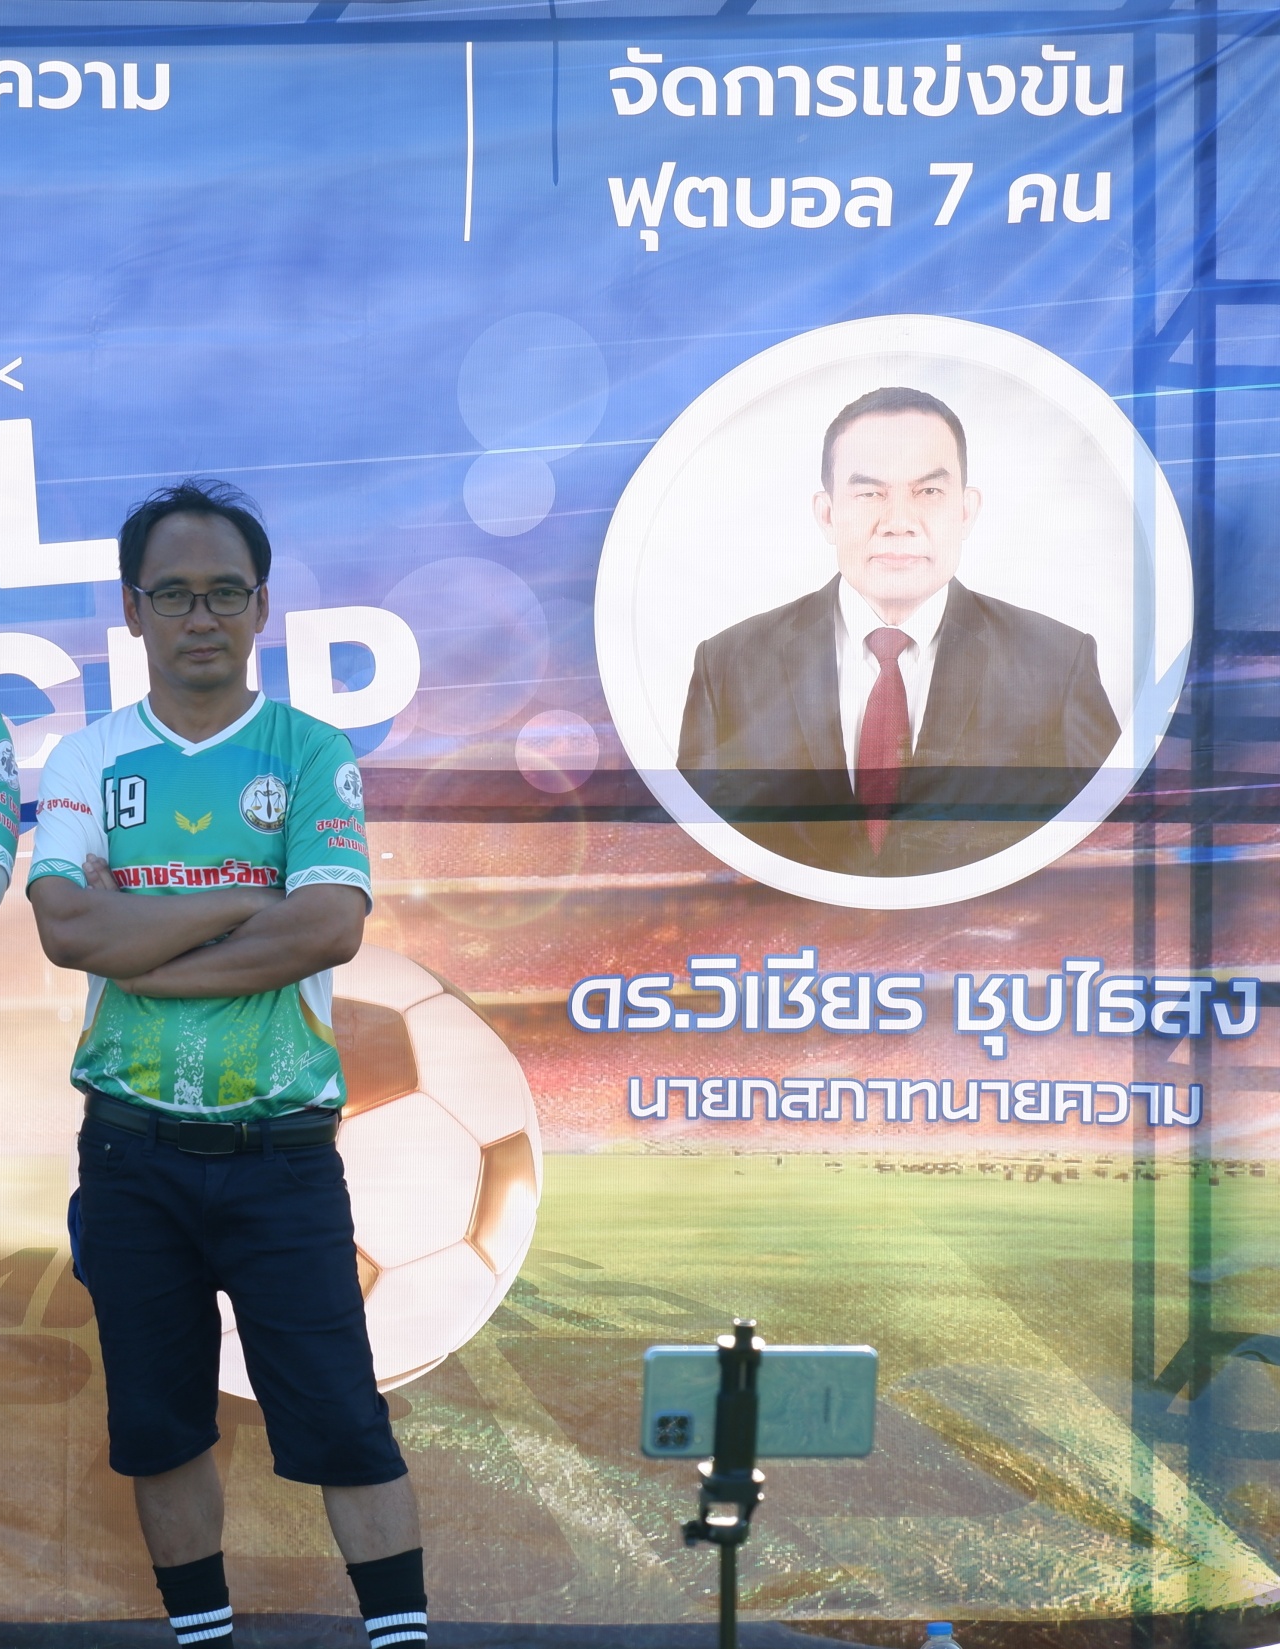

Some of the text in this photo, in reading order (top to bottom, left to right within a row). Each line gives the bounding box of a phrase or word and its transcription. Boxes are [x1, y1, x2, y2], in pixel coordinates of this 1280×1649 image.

[608, 44, 1124, 117] จัดการแข่งขัน
[607, 161, 1112, 252] ฟุตบอล 7 คน
[568, 947, 1261, 1060] ดร.วิเชียร ชุบไธสง
[627, 1076, 1205, 1127] นายกสภาทนายความ
